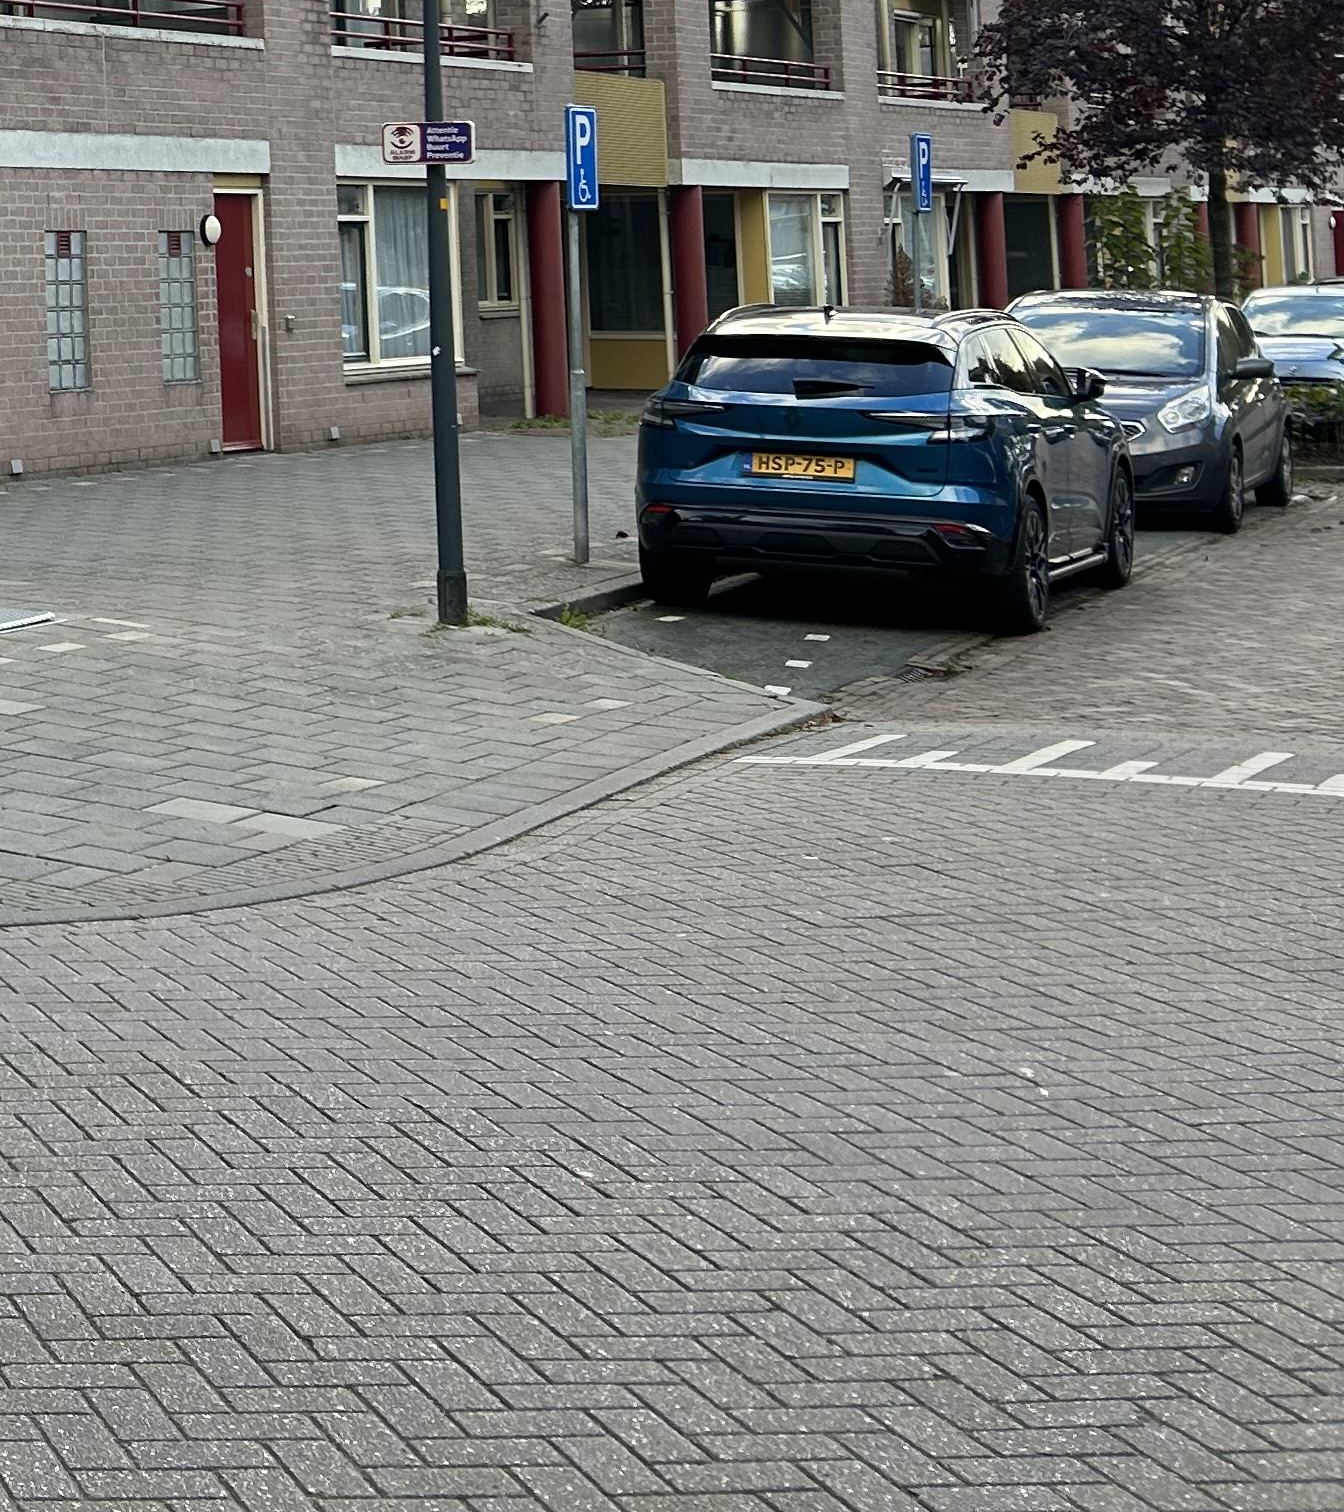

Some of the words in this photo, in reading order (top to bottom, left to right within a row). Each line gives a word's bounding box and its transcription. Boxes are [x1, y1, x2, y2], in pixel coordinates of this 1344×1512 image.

[426, 135, 468, 144] WhatsApp
[575, 115, 591, 164] P
[919, 141, 928, 179] P
[758, 456, 845, 474] HSP-75-P
